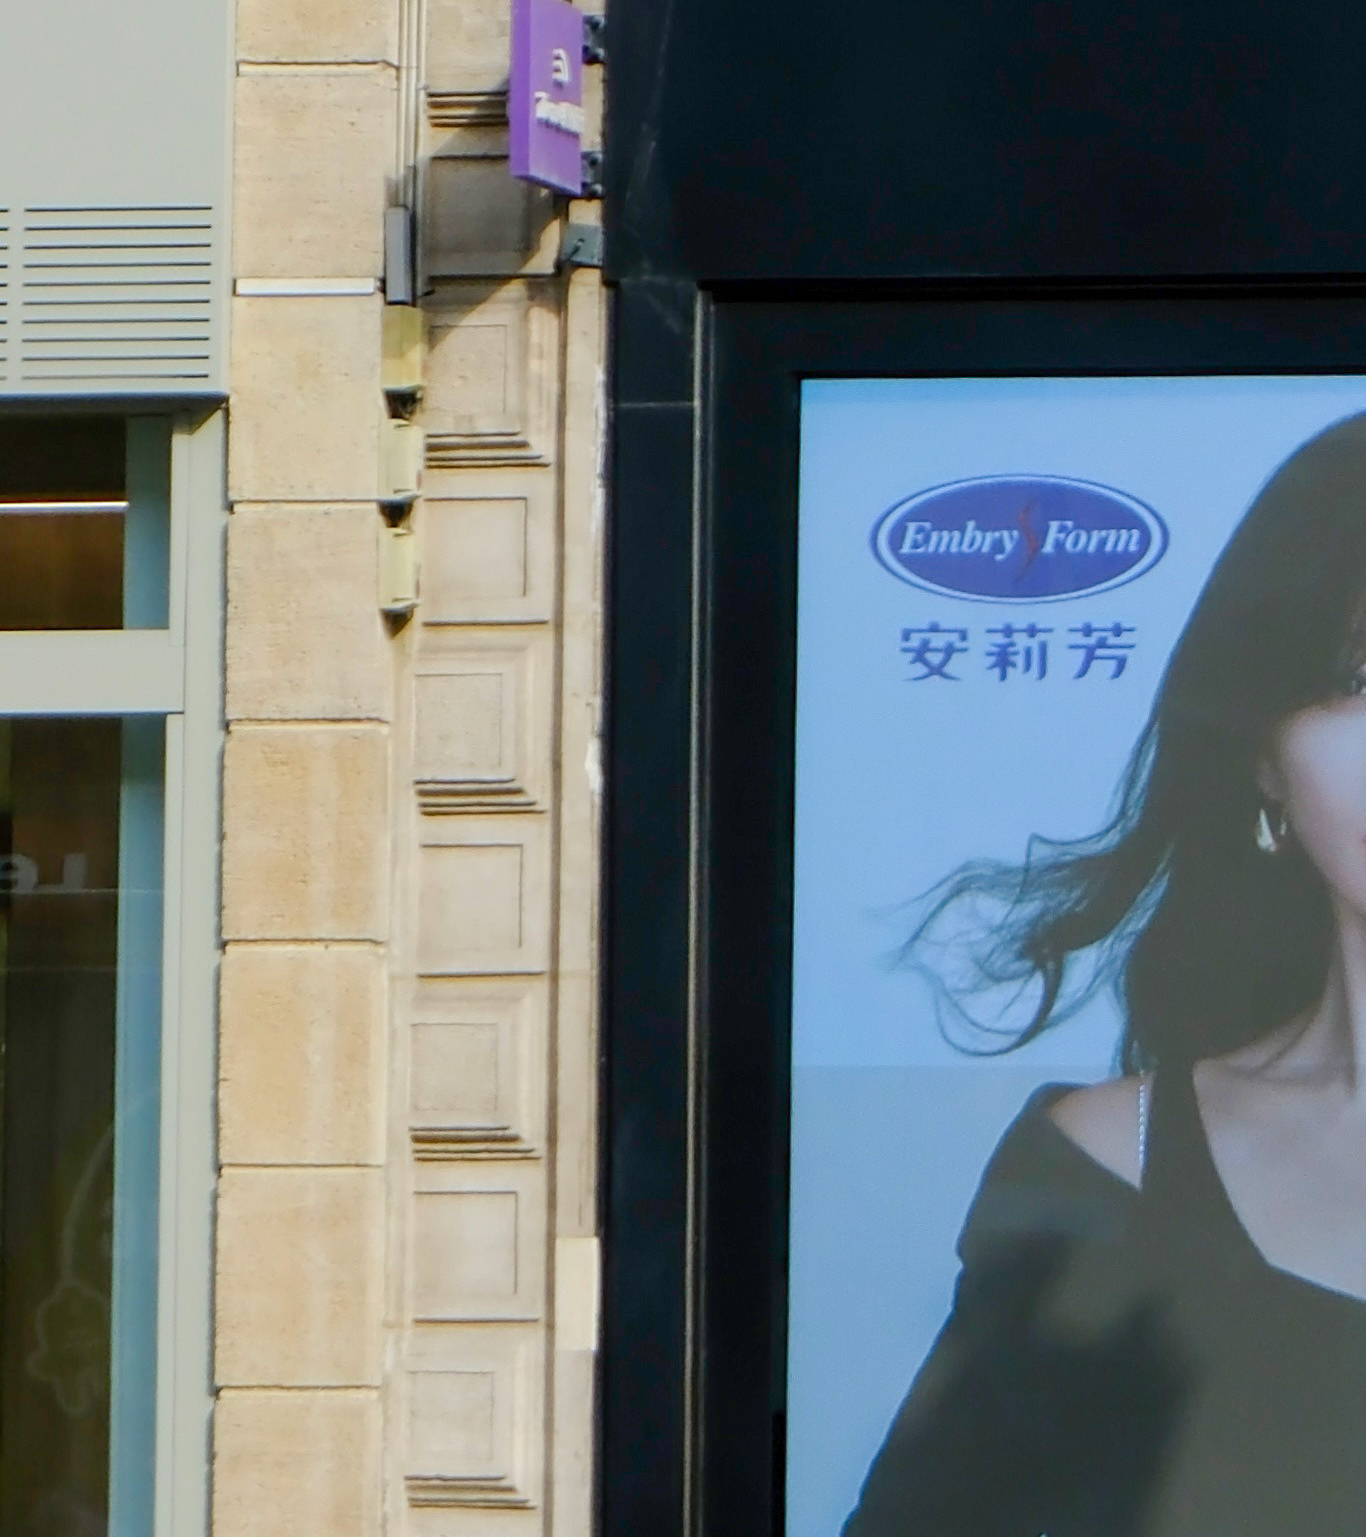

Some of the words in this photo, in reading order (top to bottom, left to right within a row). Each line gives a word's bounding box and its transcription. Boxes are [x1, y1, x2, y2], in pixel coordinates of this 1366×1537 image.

[899, 520, 1020, 561] Embry
[1041, 520, 1141, 554] Form
[900, 621, 1137, 682] 安莉芳
